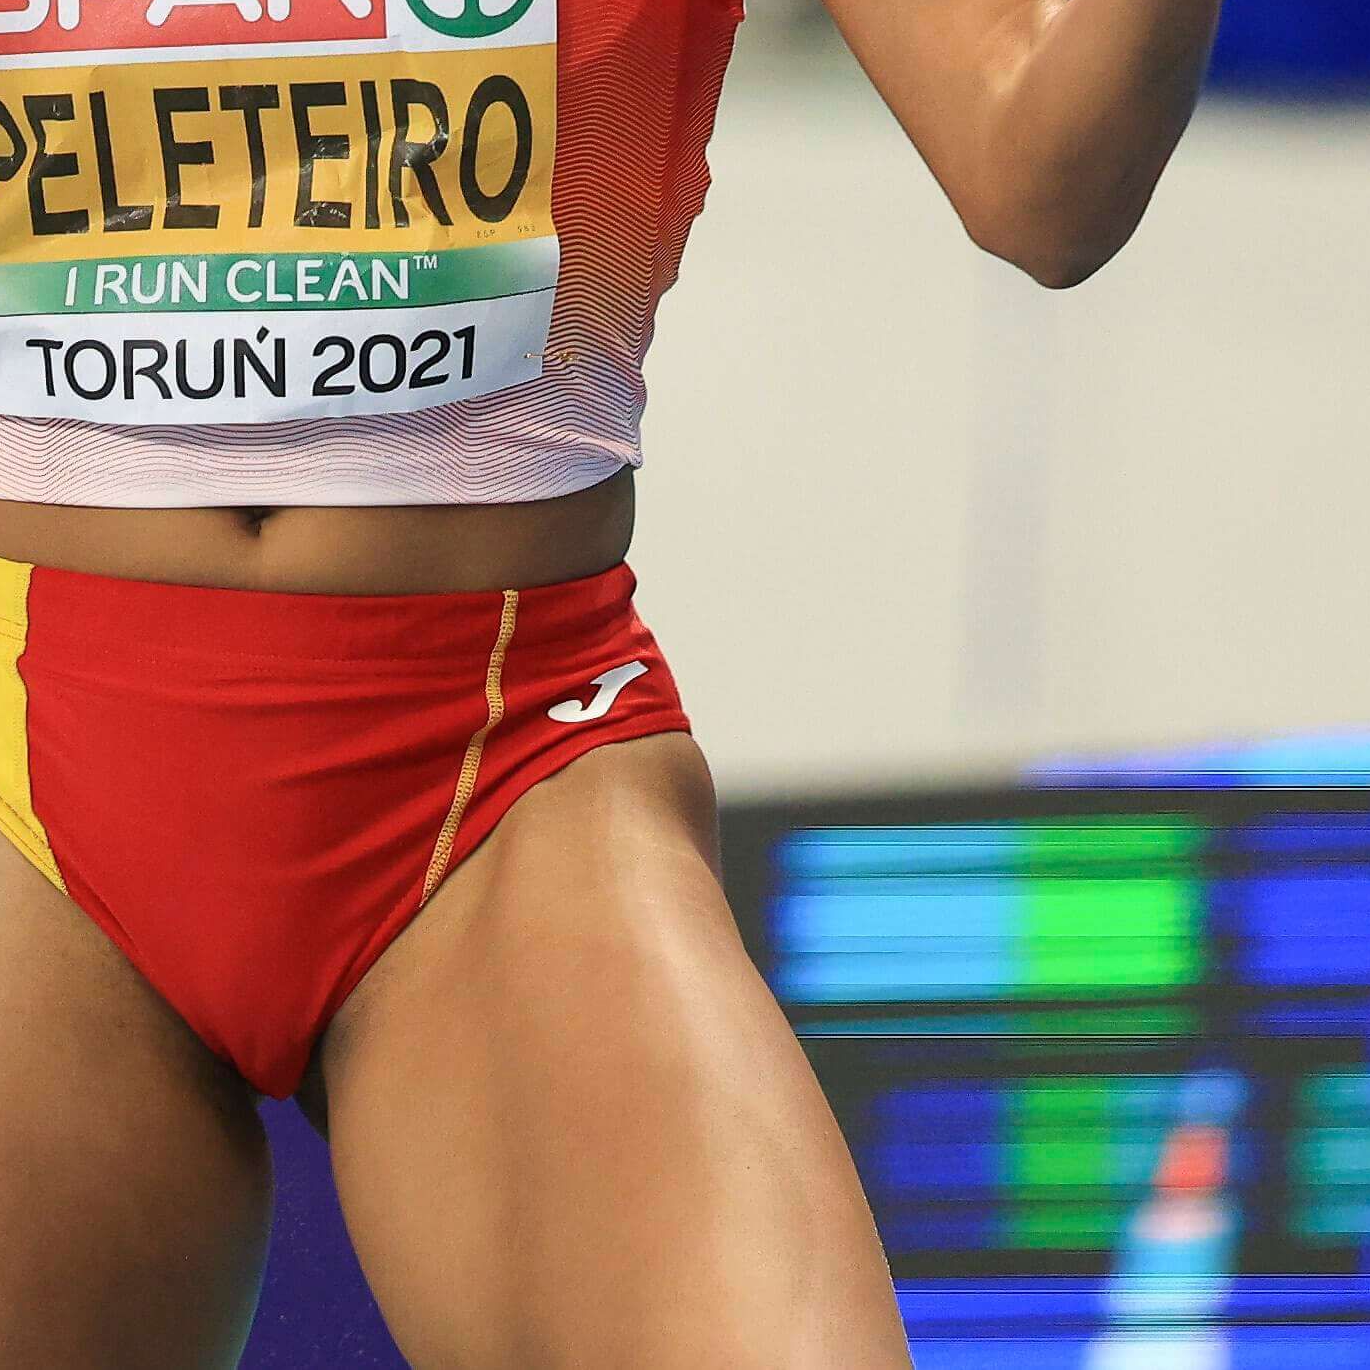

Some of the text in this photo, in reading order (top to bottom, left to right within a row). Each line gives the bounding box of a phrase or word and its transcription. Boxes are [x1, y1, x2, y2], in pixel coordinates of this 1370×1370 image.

[64, 267, 77, 307] I
[94, 260, 207, 306] RUN
[26, 325, 476, 401] TORUŃ 2021
